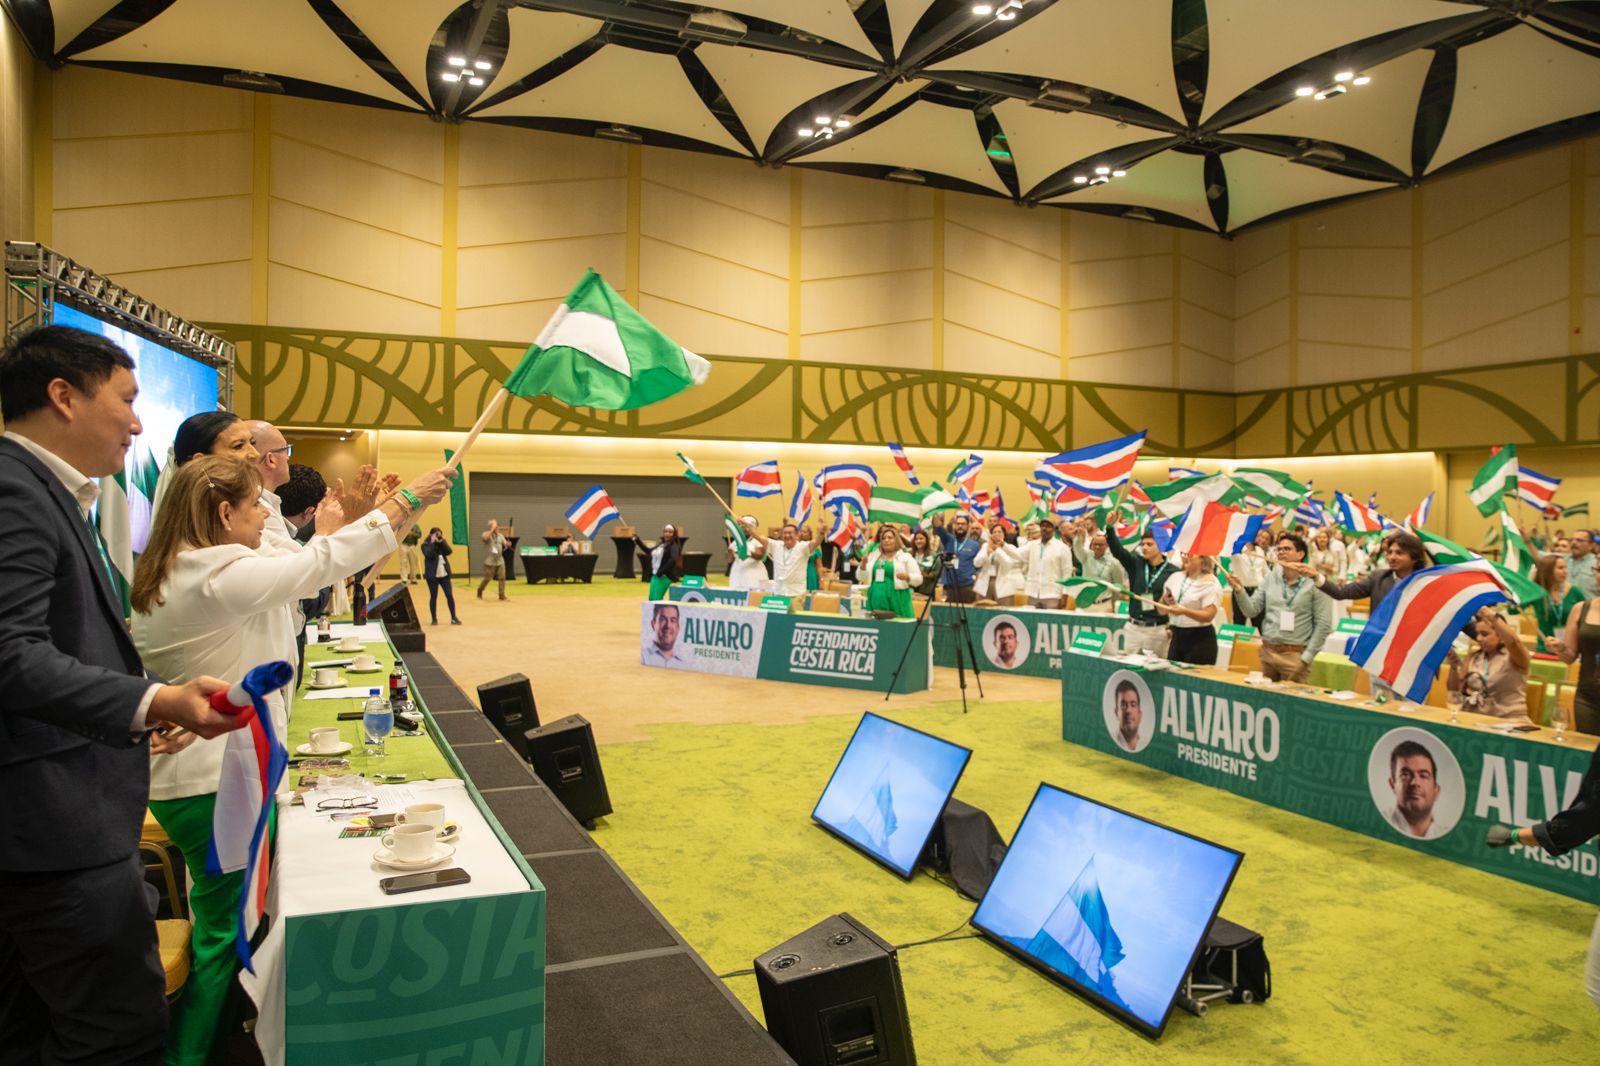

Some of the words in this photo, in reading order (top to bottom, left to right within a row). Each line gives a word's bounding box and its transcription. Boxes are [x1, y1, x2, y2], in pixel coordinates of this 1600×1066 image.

[683, 617, 753, 650] ALVARO
[792, 628, 879, 652] DEFENDAMOS
[1034, 622, 1126, 655] ALVO
[694, 649, 741, 661] PRESIDENTE
[789, 647, 834, 670] COSTA
[837, 651, 875, 674] RICA
[1160, 686, 1280, 763] ALVARO
[1177, 742, 1258, 781] PRESIDENTE
[1509, 844, 1600, 879] PRESID
